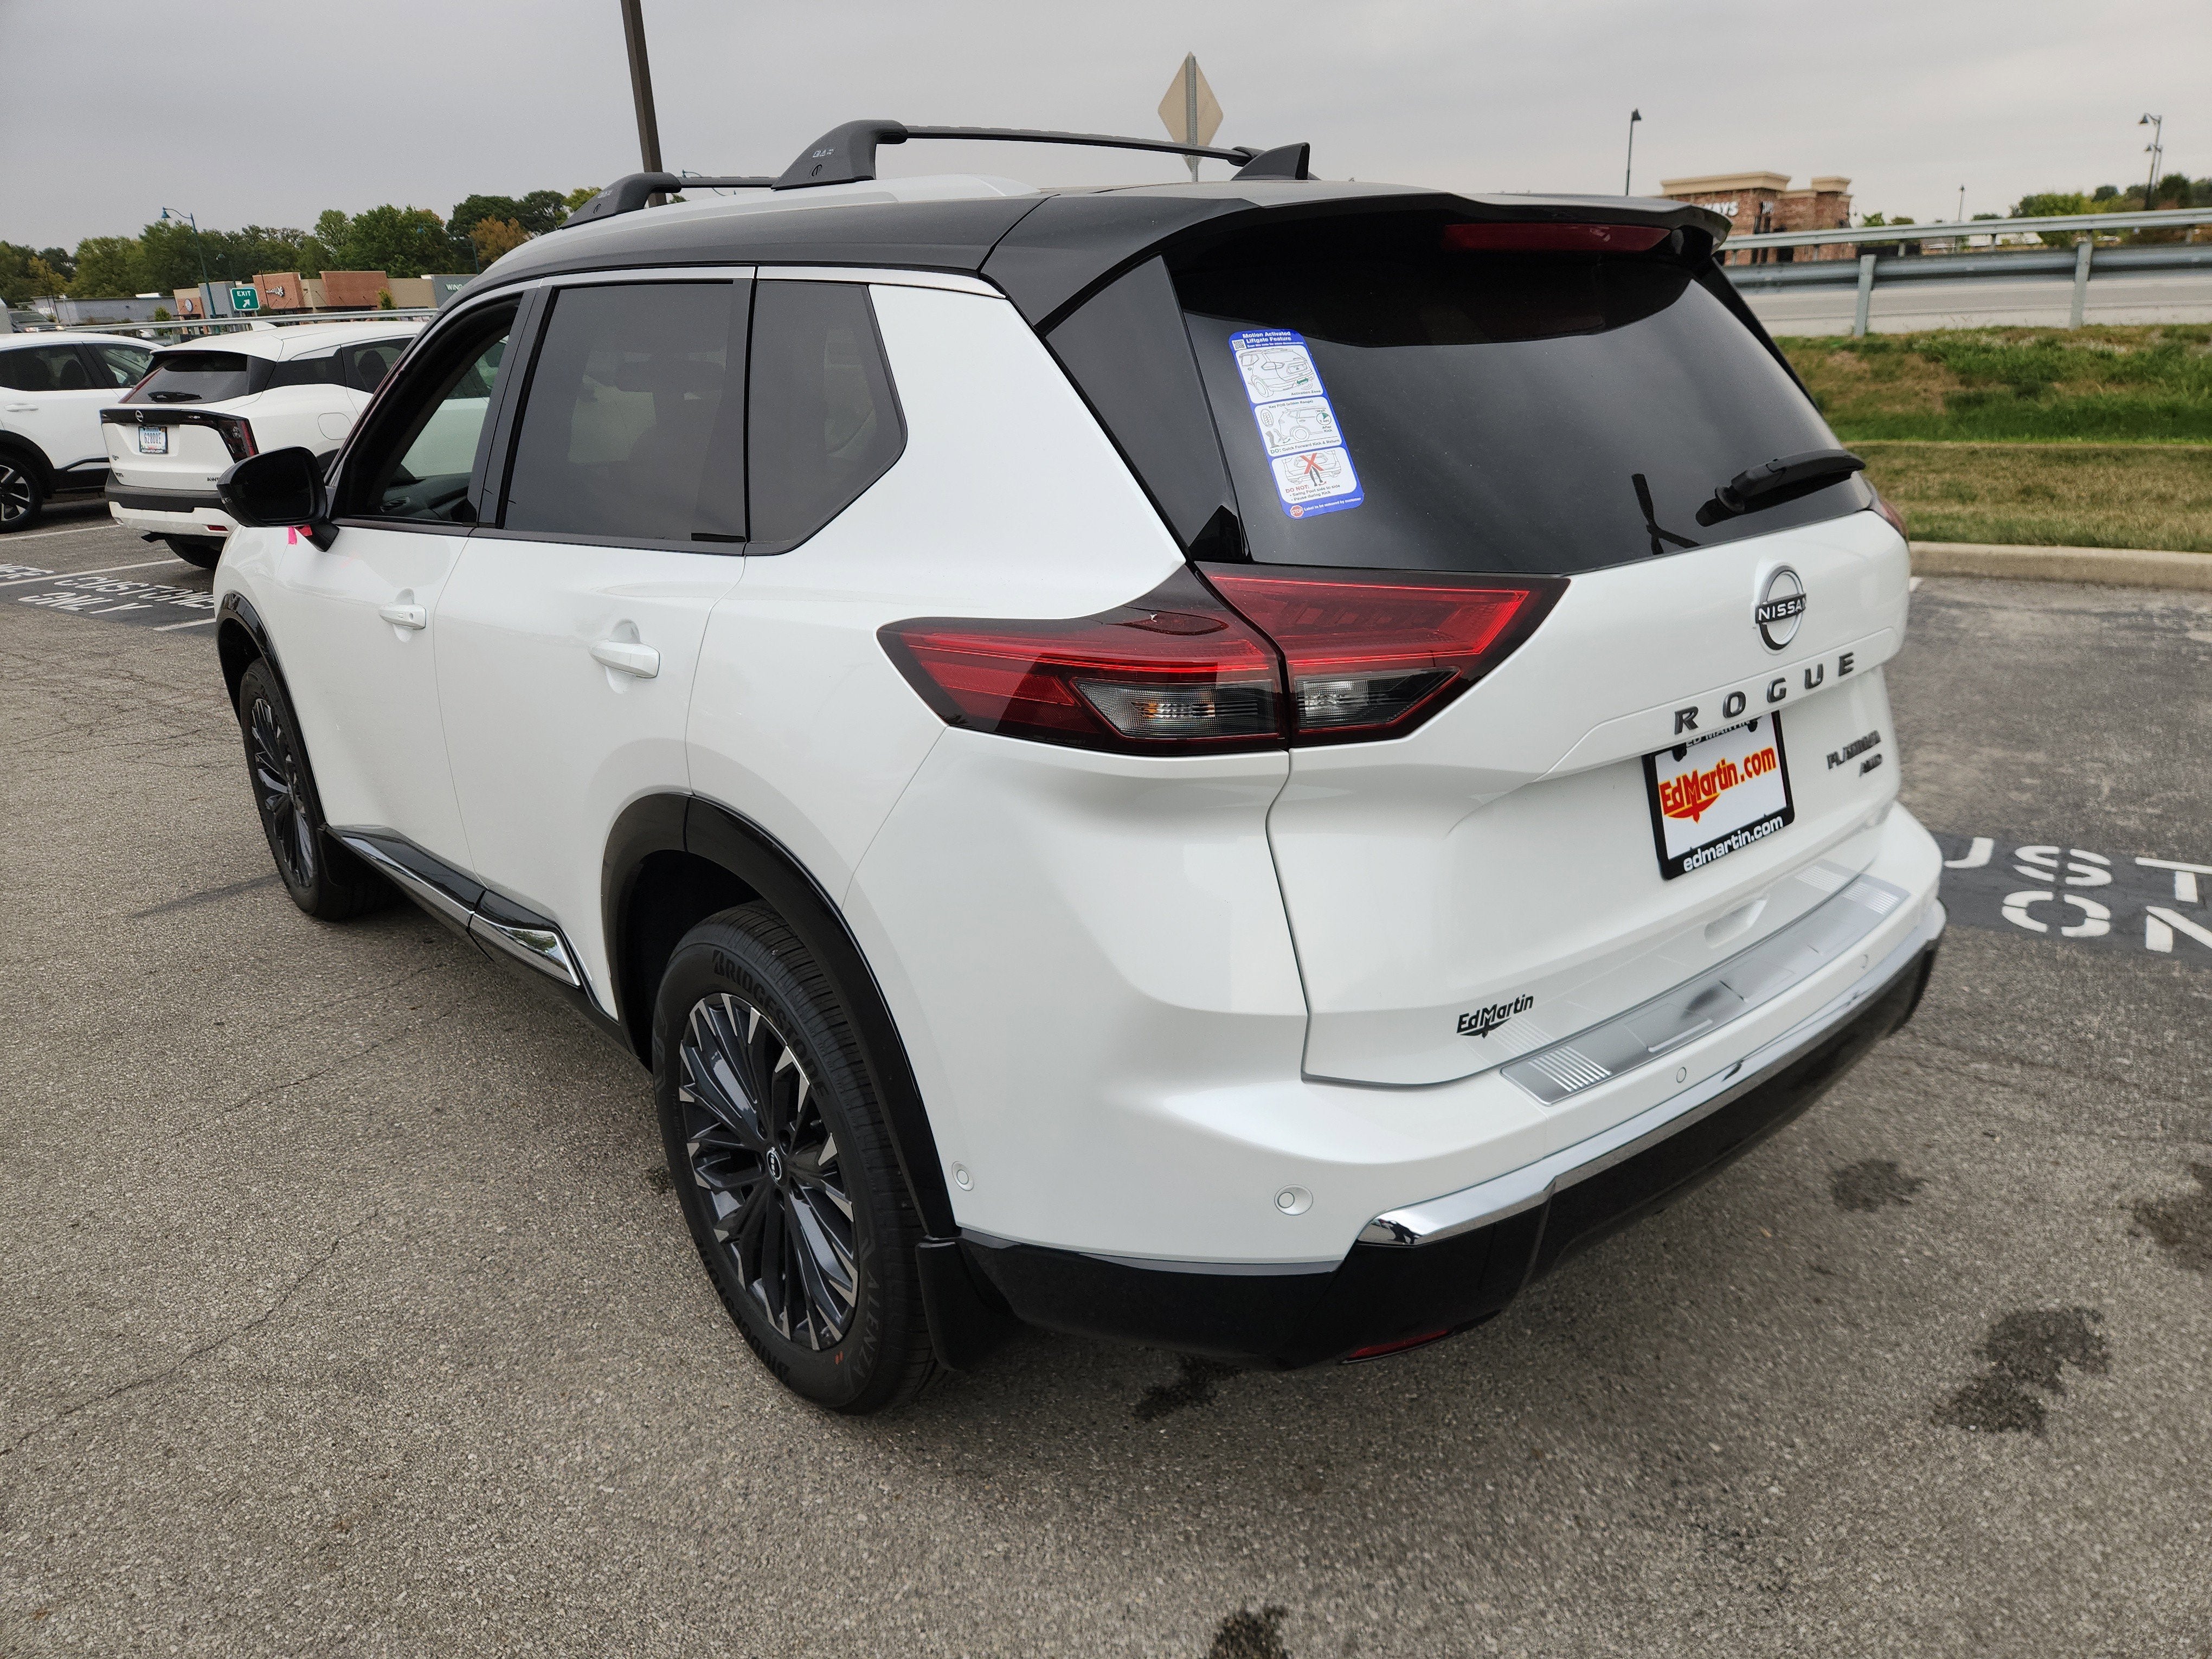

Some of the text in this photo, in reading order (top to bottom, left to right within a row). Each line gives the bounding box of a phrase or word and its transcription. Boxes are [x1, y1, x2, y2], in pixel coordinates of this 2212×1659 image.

[18, 591, 153, 614] ONLY
[54, 576, 214, 609] CUSTOME
[1674, 651, 1855, 735] ROGUE
[1659, 747, 1777, 816] EdMartin.com
[1683, 815, 1783, 872] edmartin.com
[1456, 993, 1534, 1034] EdMartin
